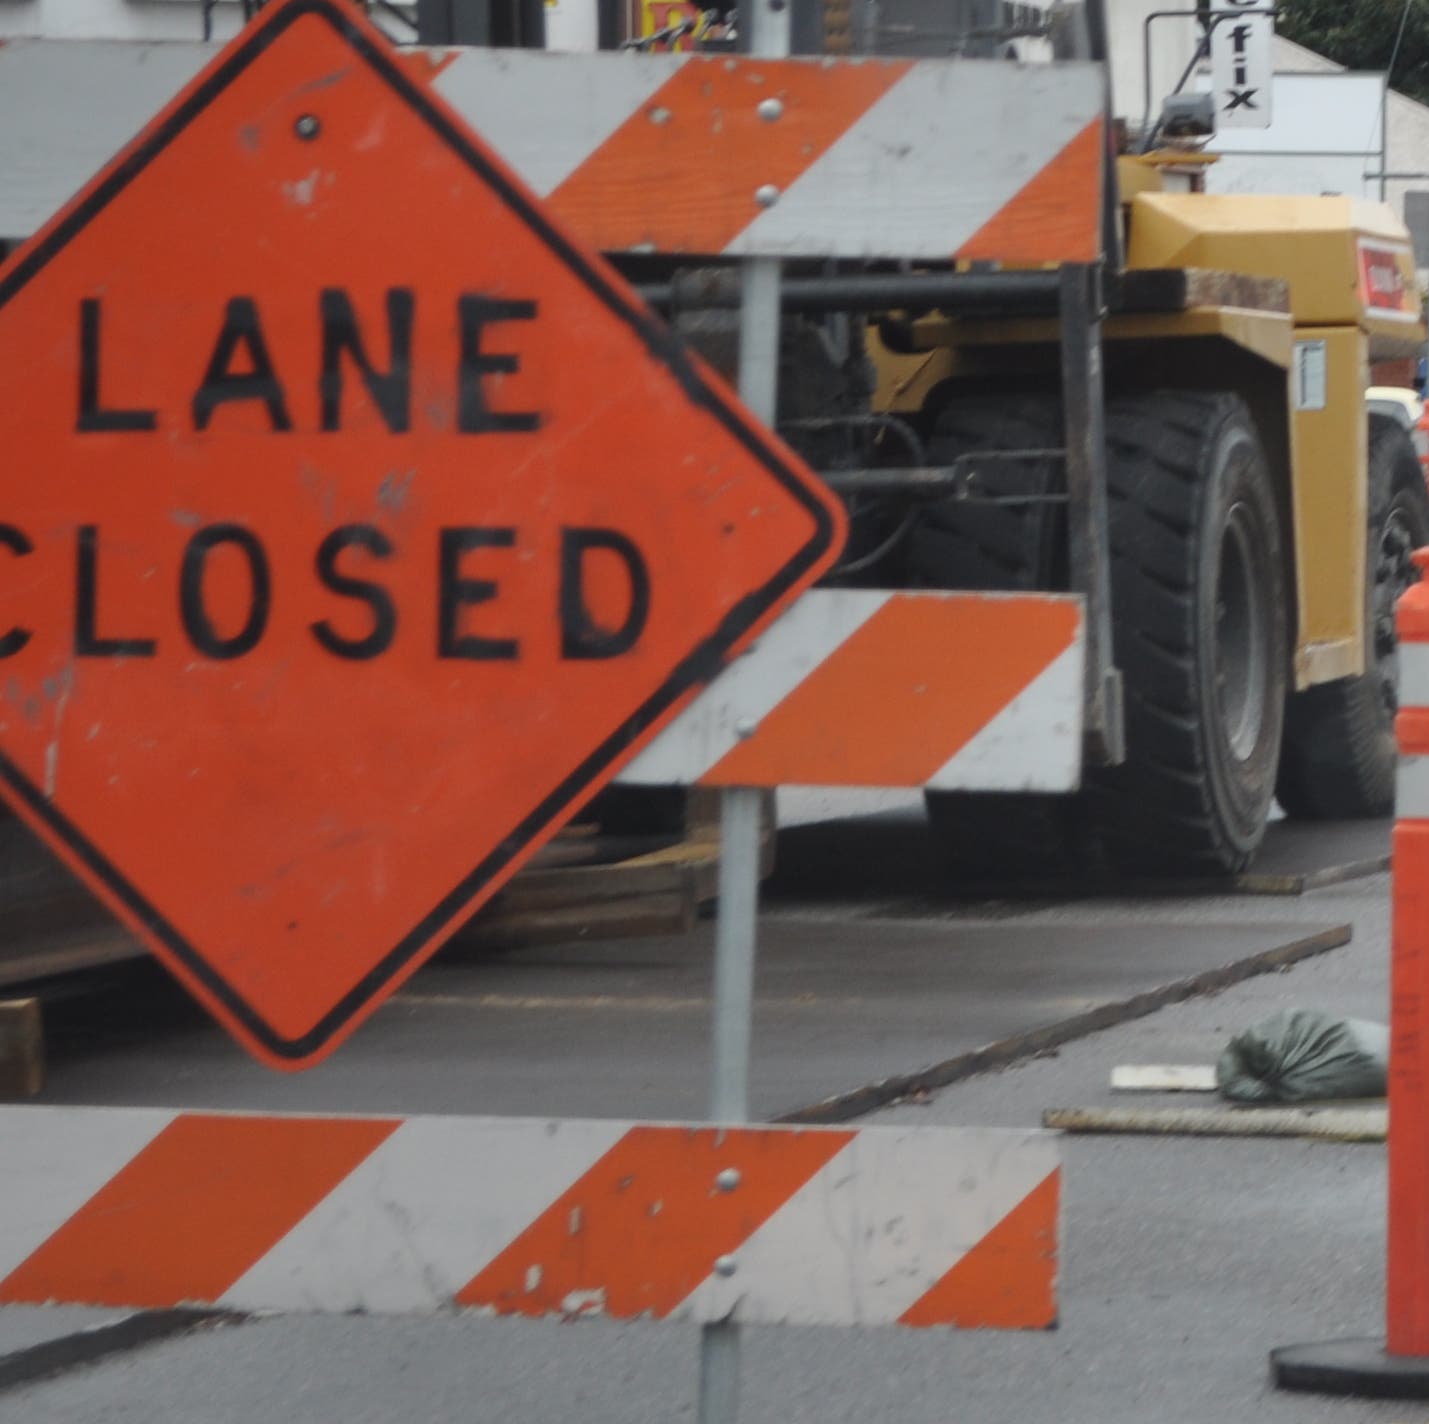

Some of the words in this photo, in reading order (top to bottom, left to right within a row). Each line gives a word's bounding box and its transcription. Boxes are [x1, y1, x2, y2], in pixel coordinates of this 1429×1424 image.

[1222, 24, 1259, 110] fix
[76, 286, 542, 434] LANE
[0, 522, 652, 661] CLOSED
